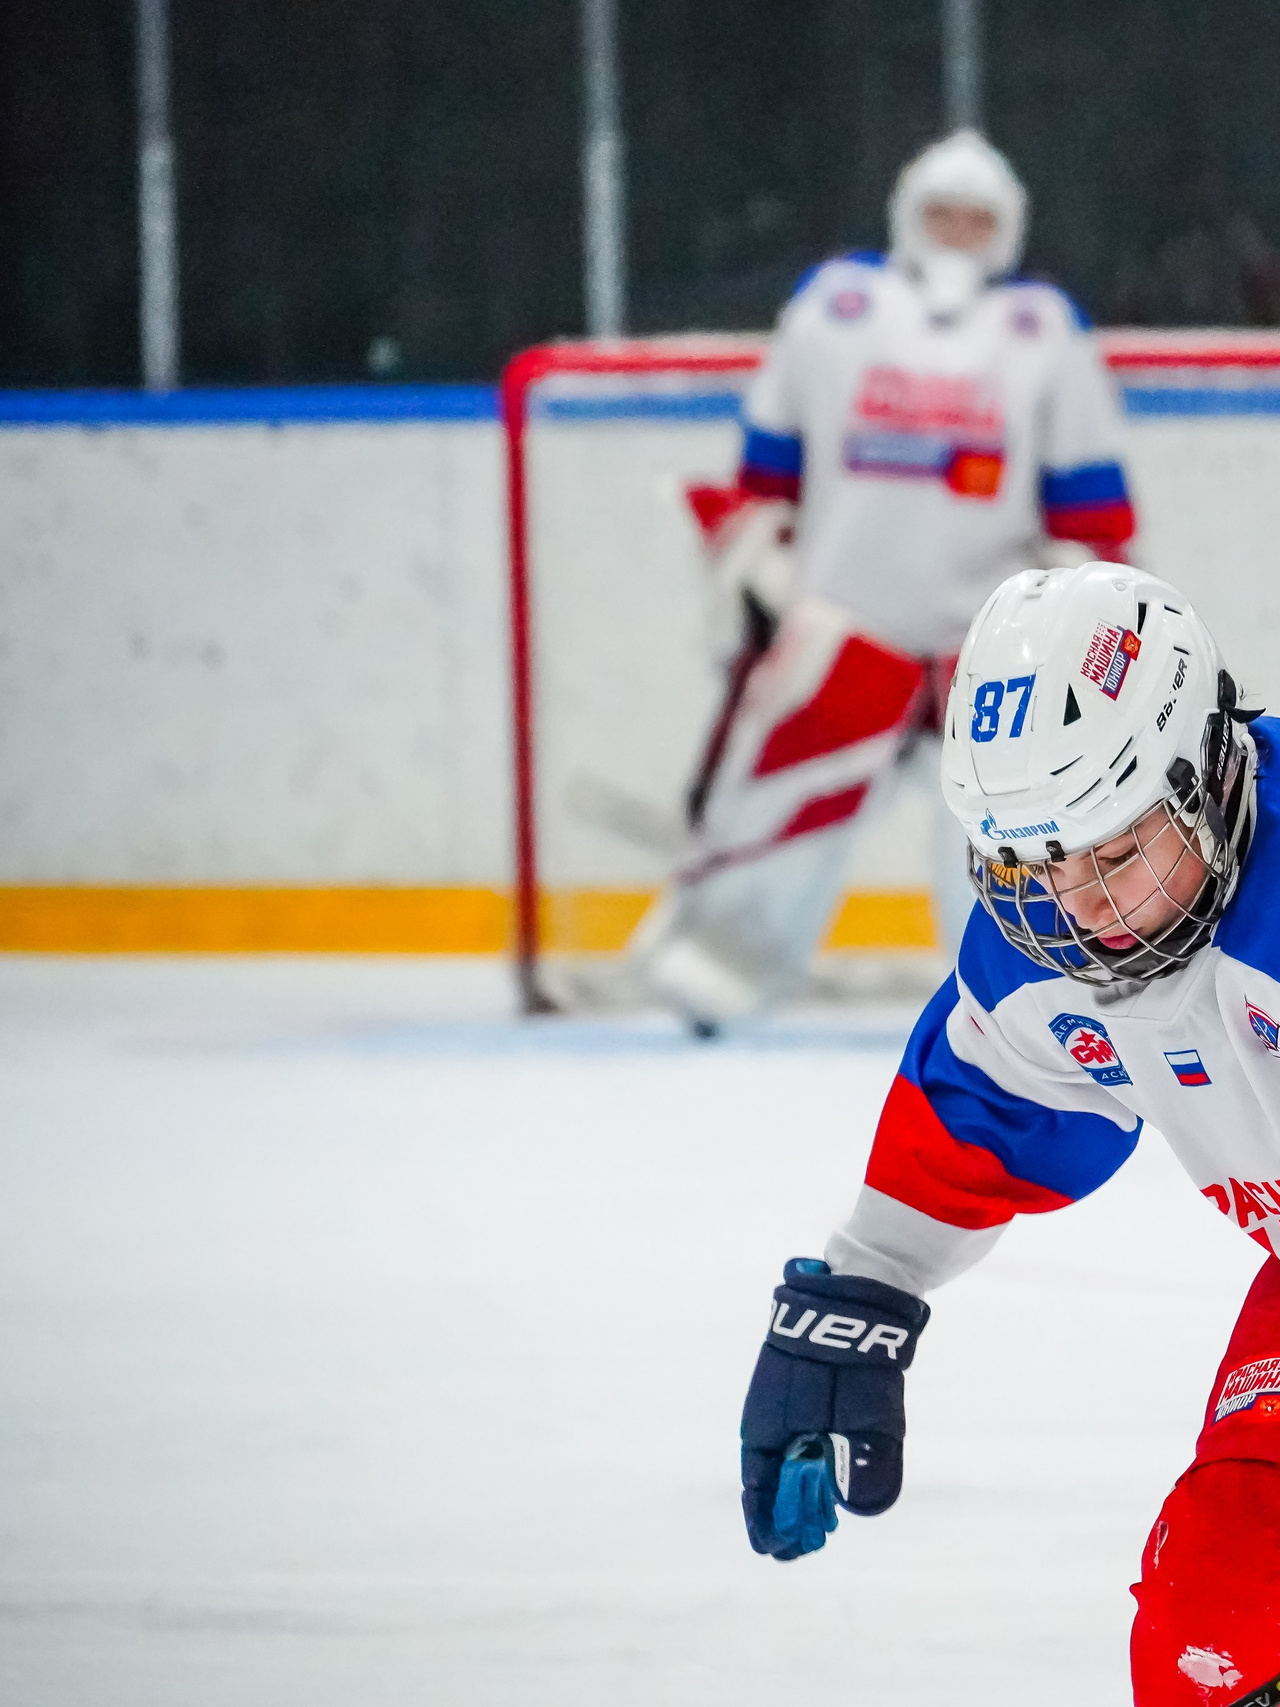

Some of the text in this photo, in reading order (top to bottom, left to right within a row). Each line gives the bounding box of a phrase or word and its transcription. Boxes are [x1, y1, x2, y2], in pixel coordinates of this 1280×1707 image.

[1080, 633, 1103, 678] КРАСНАЯ
[1090, 628, 1120, 686] МАШИНА
[1105, 651, 1127, 691] ЮНИОР
[971, 674, 1036, 743] 87
[1003, 820, 1060, 839] ГАЗПРОМ
[769, 1298, 909, 1360] UER
